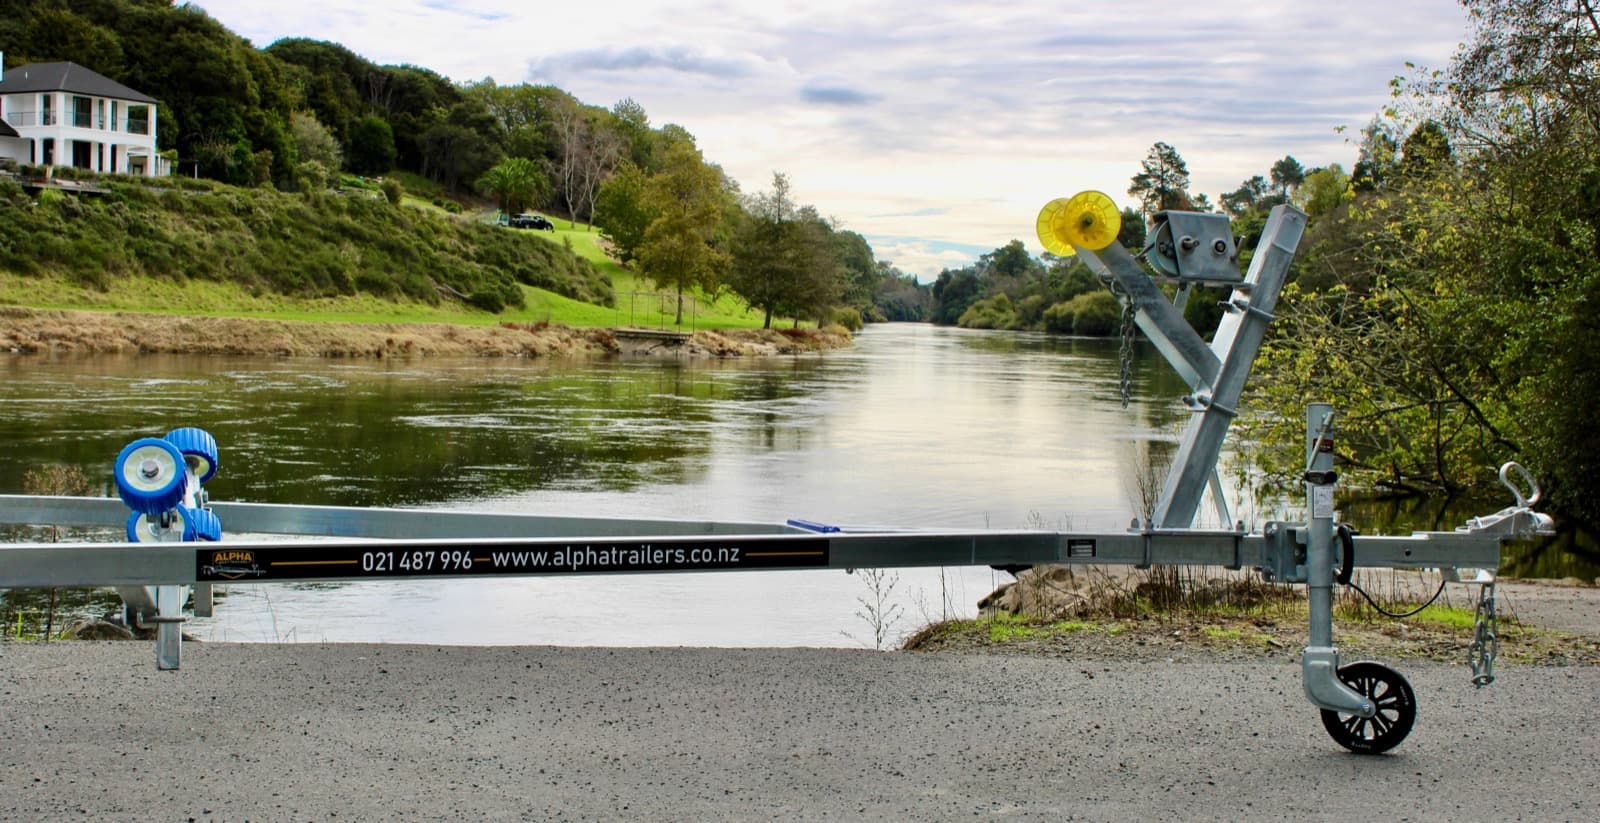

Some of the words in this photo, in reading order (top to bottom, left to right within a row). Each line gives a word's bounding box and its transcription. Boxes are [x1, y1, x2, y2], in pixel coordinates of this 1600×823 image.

[215, 552, 252, 562] ALPHA
[362, 552, 394, 571] 021
[399, 551, 435, 570] 487
[440, 550, 472, 570] 996
[492, 545, 741, 571] www.alphatrailers.co.nz
